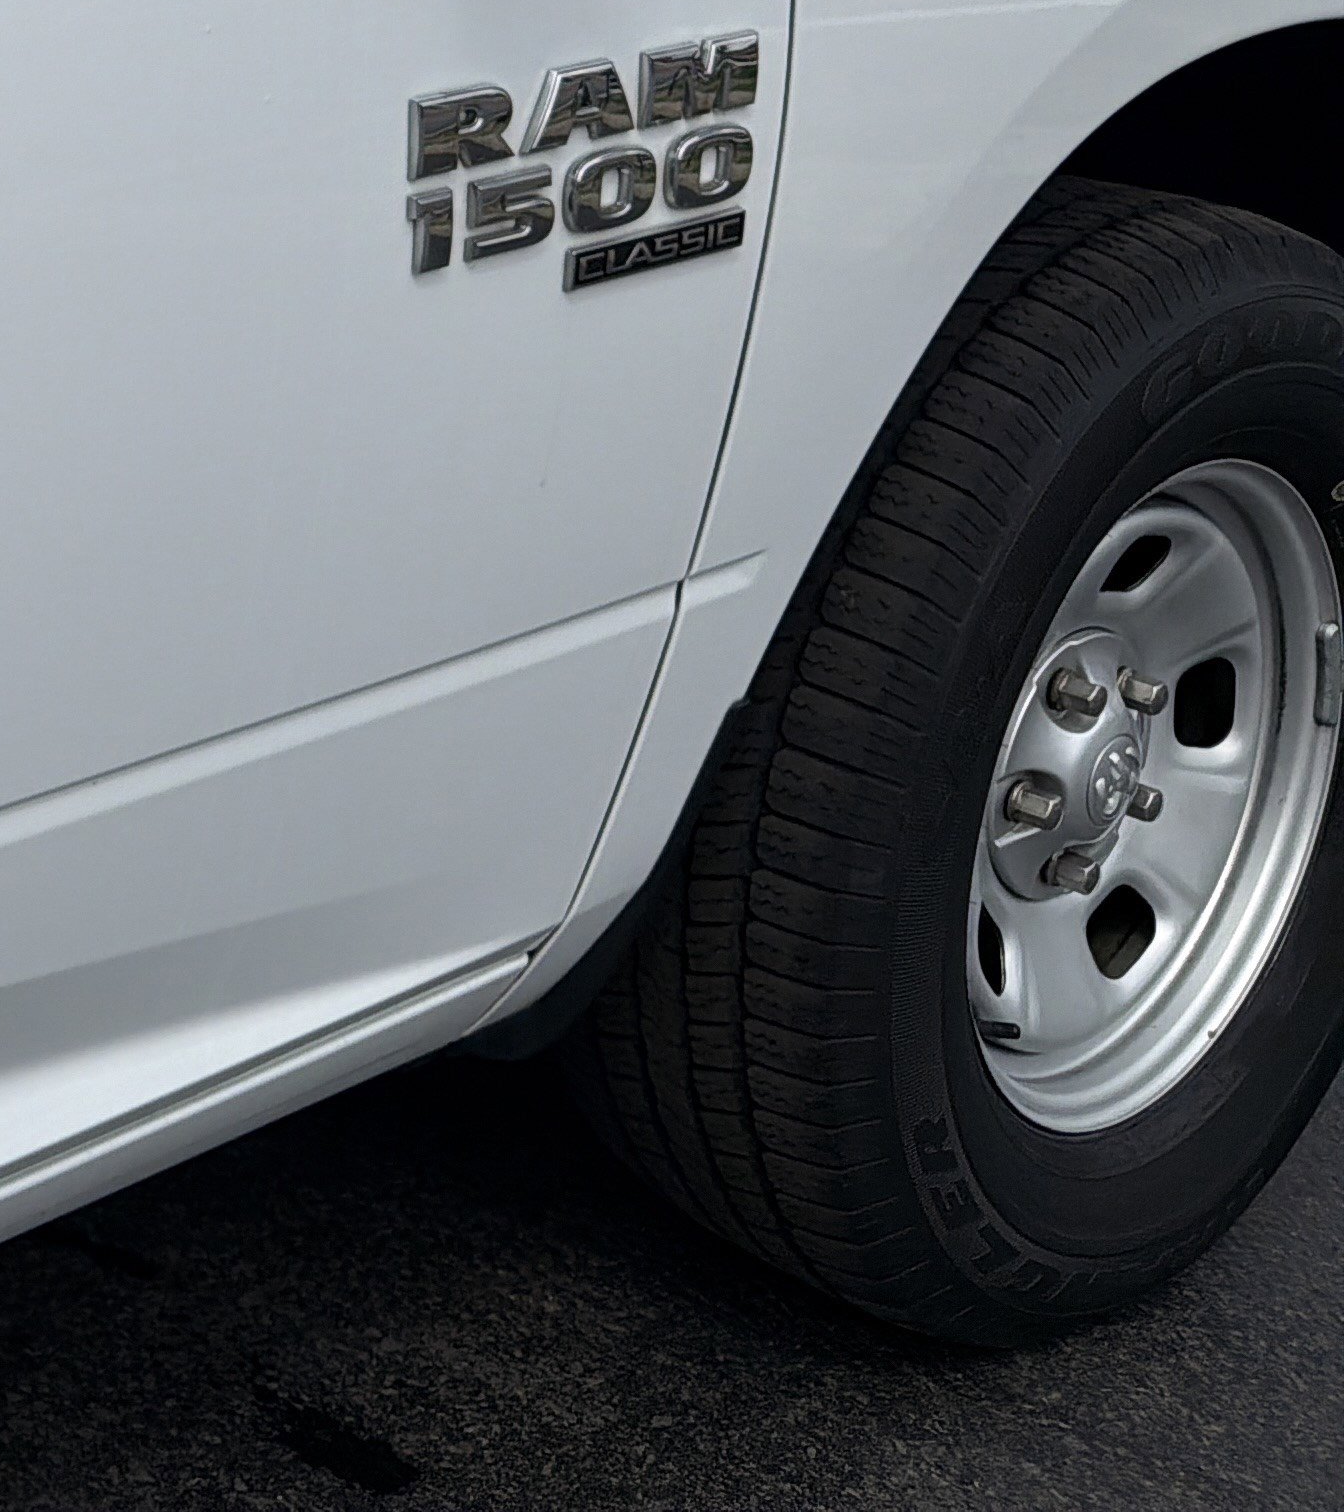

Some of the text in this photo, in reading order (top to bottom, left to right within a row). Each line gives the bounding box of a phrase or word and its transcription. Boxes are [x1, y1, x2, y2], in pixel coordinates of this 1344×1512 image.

[408, 29, 760, 181] RAM
[407, 123, 754, 276] 1500
[577, 217, 741, 282] CLASSIC
